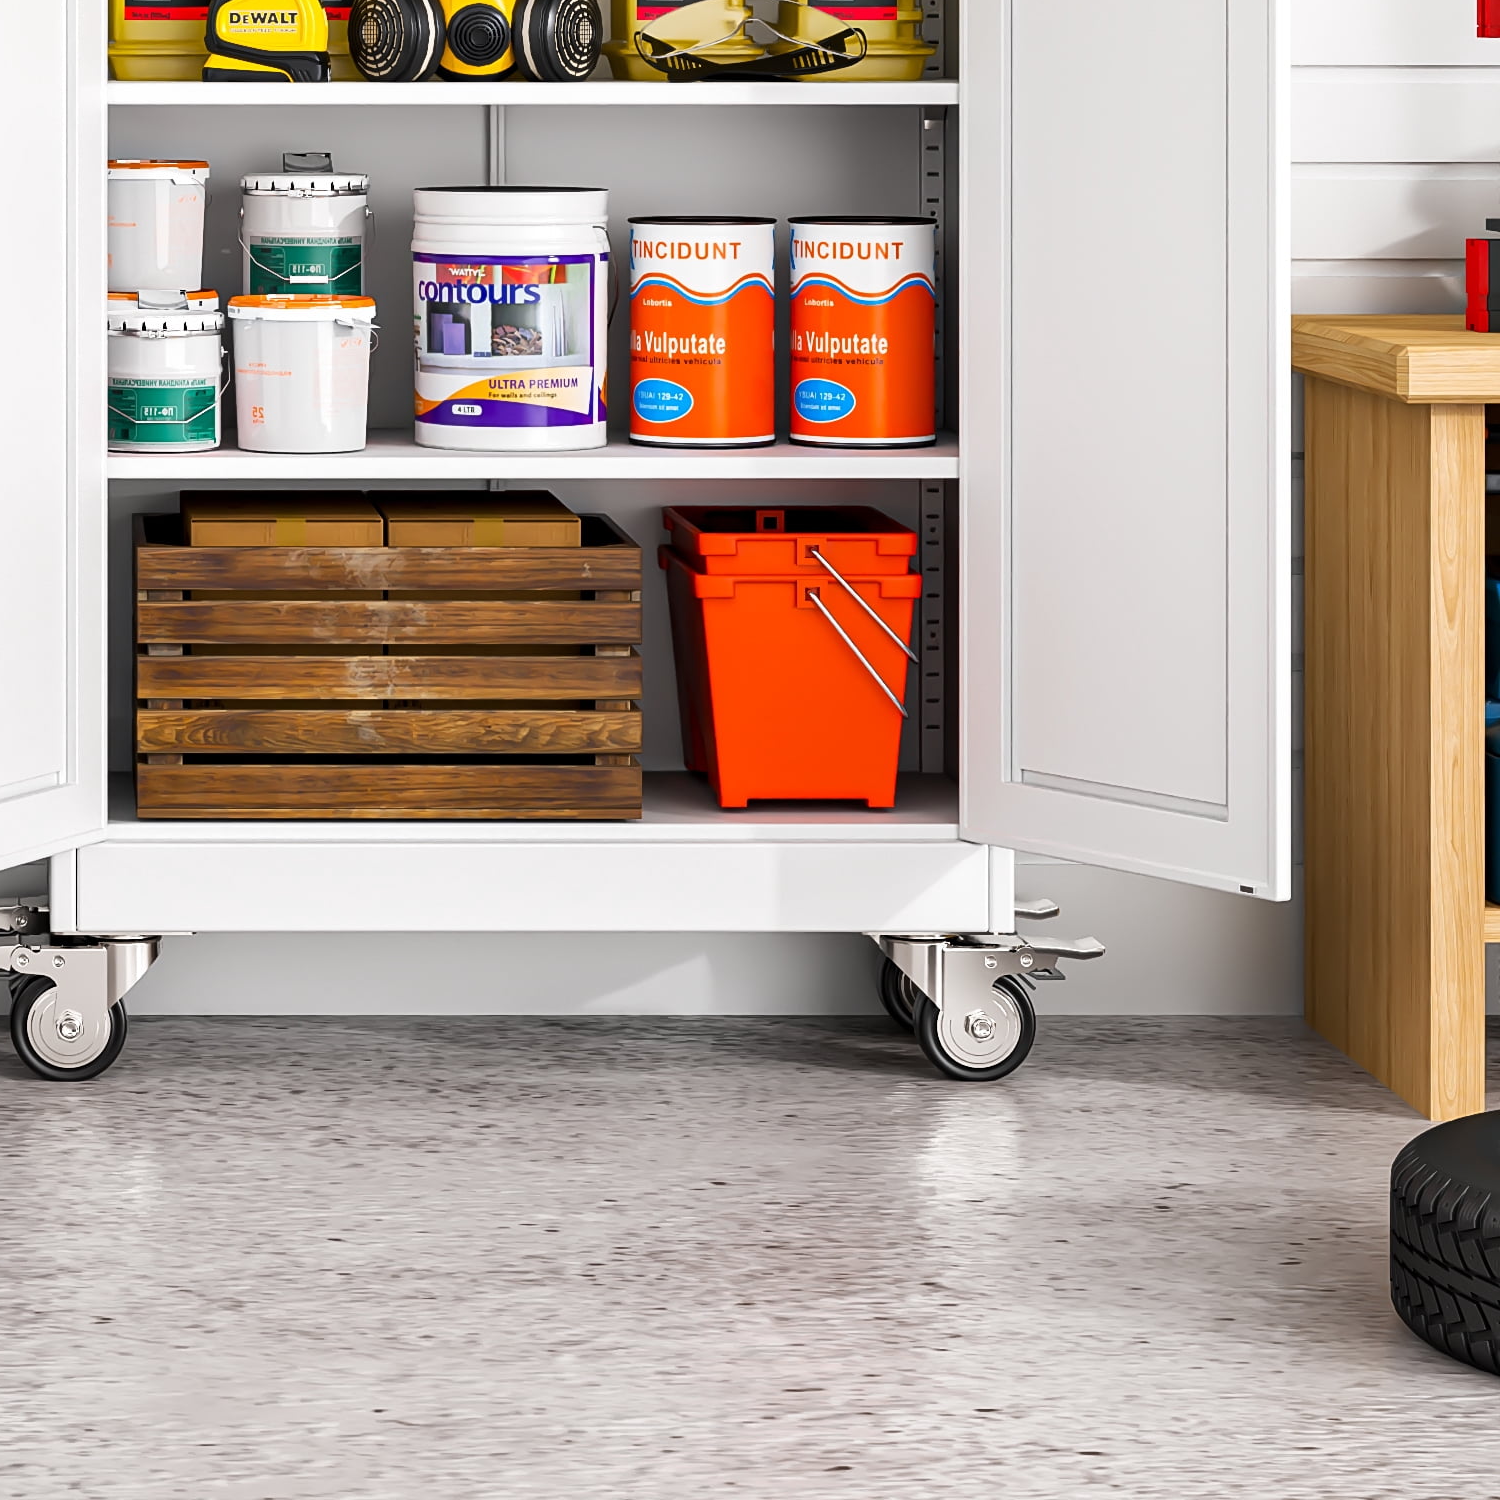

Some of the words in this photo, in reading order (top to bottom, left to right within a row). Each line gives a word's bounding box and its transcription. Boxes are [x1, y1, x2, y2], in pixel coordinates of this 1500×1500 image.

[633, 240, 742, 260] TINCIDUNT
[794, 240, 904, 260] TINCIDUNT
[419, 279, 541, 305] contours
[644, 331, 726, 359] Vulputate
[805, 331, 889, 359] Vulputate
[489, 379, 525, 389] ULTRA
[529, 378, 578, 388] PREMIUM
